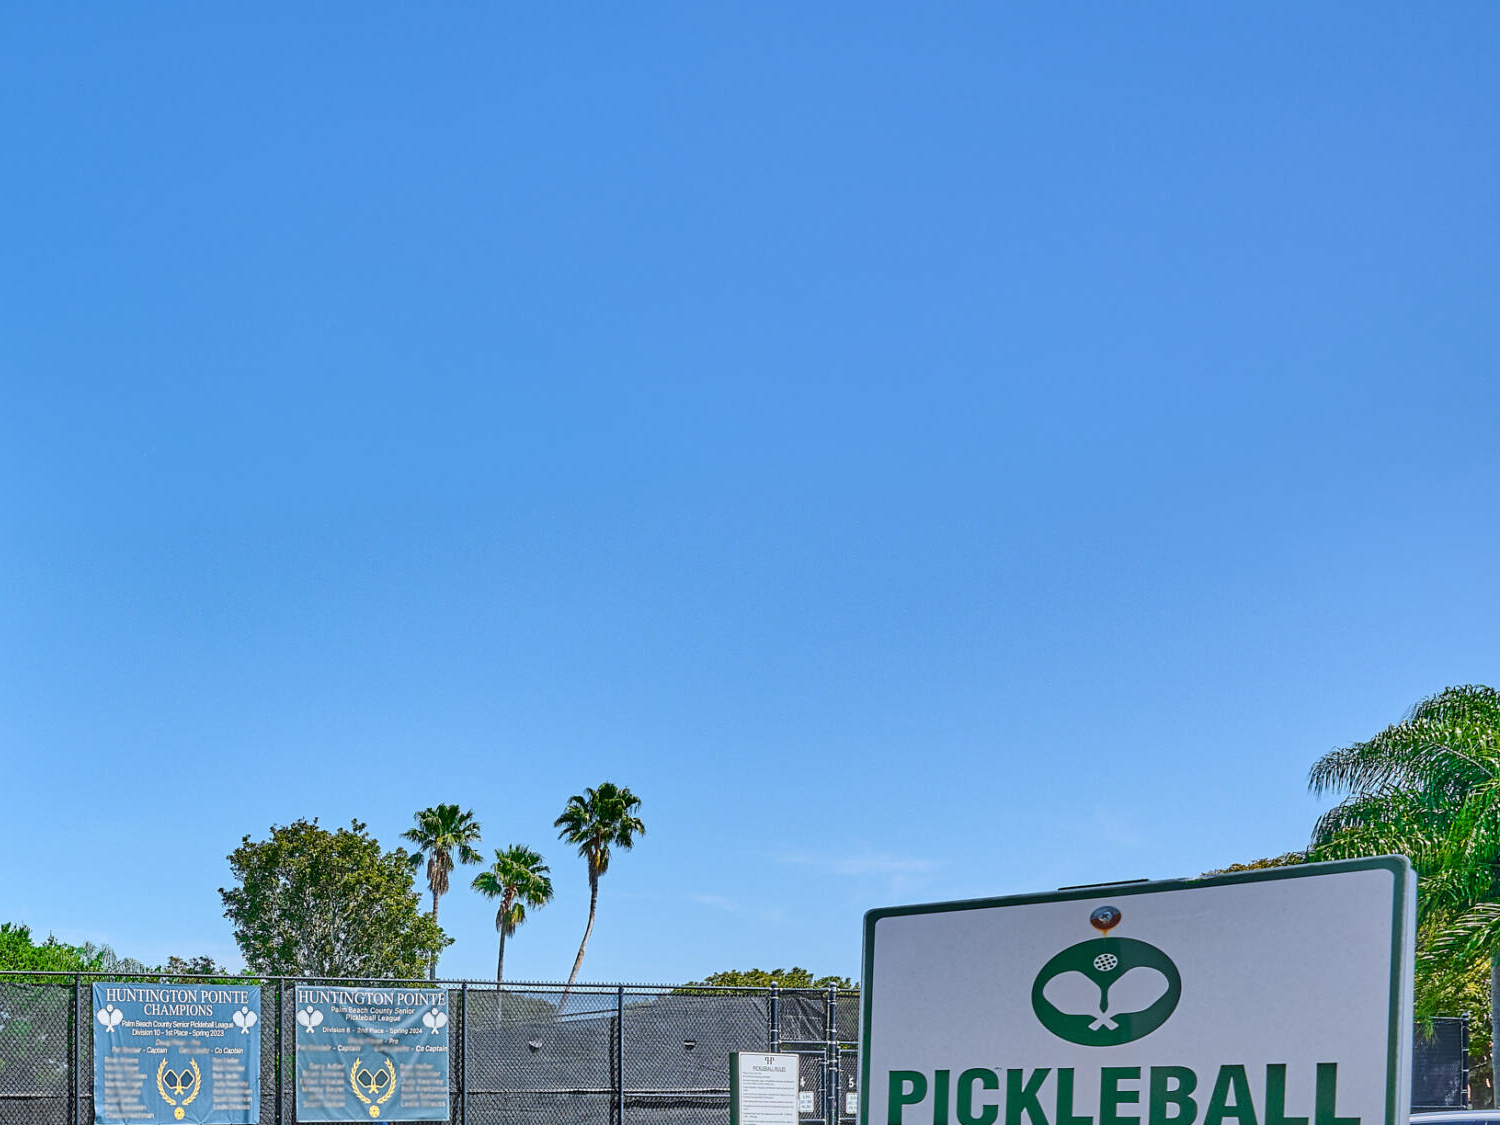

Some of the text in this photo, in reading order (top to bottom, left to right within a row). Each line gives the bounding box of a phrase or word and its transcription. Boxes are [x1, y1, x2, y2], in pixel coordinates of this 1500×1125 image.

[106, 988, 249, 1004] HUNTINGTON POINTE
[298, 990, 446, 1006] HUNTINGTON POINTE
[143, 1004, 213, 1016] CHAMPIONS
[348, 1006, 368, 1014] Beach
[370, 1007, 393, 1015] County
[395, 1007, 415, 1015] Senior
[377, 1015, 401, 1023] League
[121, 1019, 135, 1027] Palm
[136, 1020, 152, 1028] Beach
[153, 1020, 172, 1029] County
[215, 1022, 234, 1030] League
[174, 1029, 189, 1037] Place
[192, 1029, 210, 1038] Spring
[389, 1027, 409, 1035] Spring
[146, 1046, 168, 1055] Captain
[223, 1047, 244, 1055] Captain
[337, 1044, 361, 1053] Captain
[425, 1045, 447, 1053] Captain
[848, 1077, 855, 1088] 5
